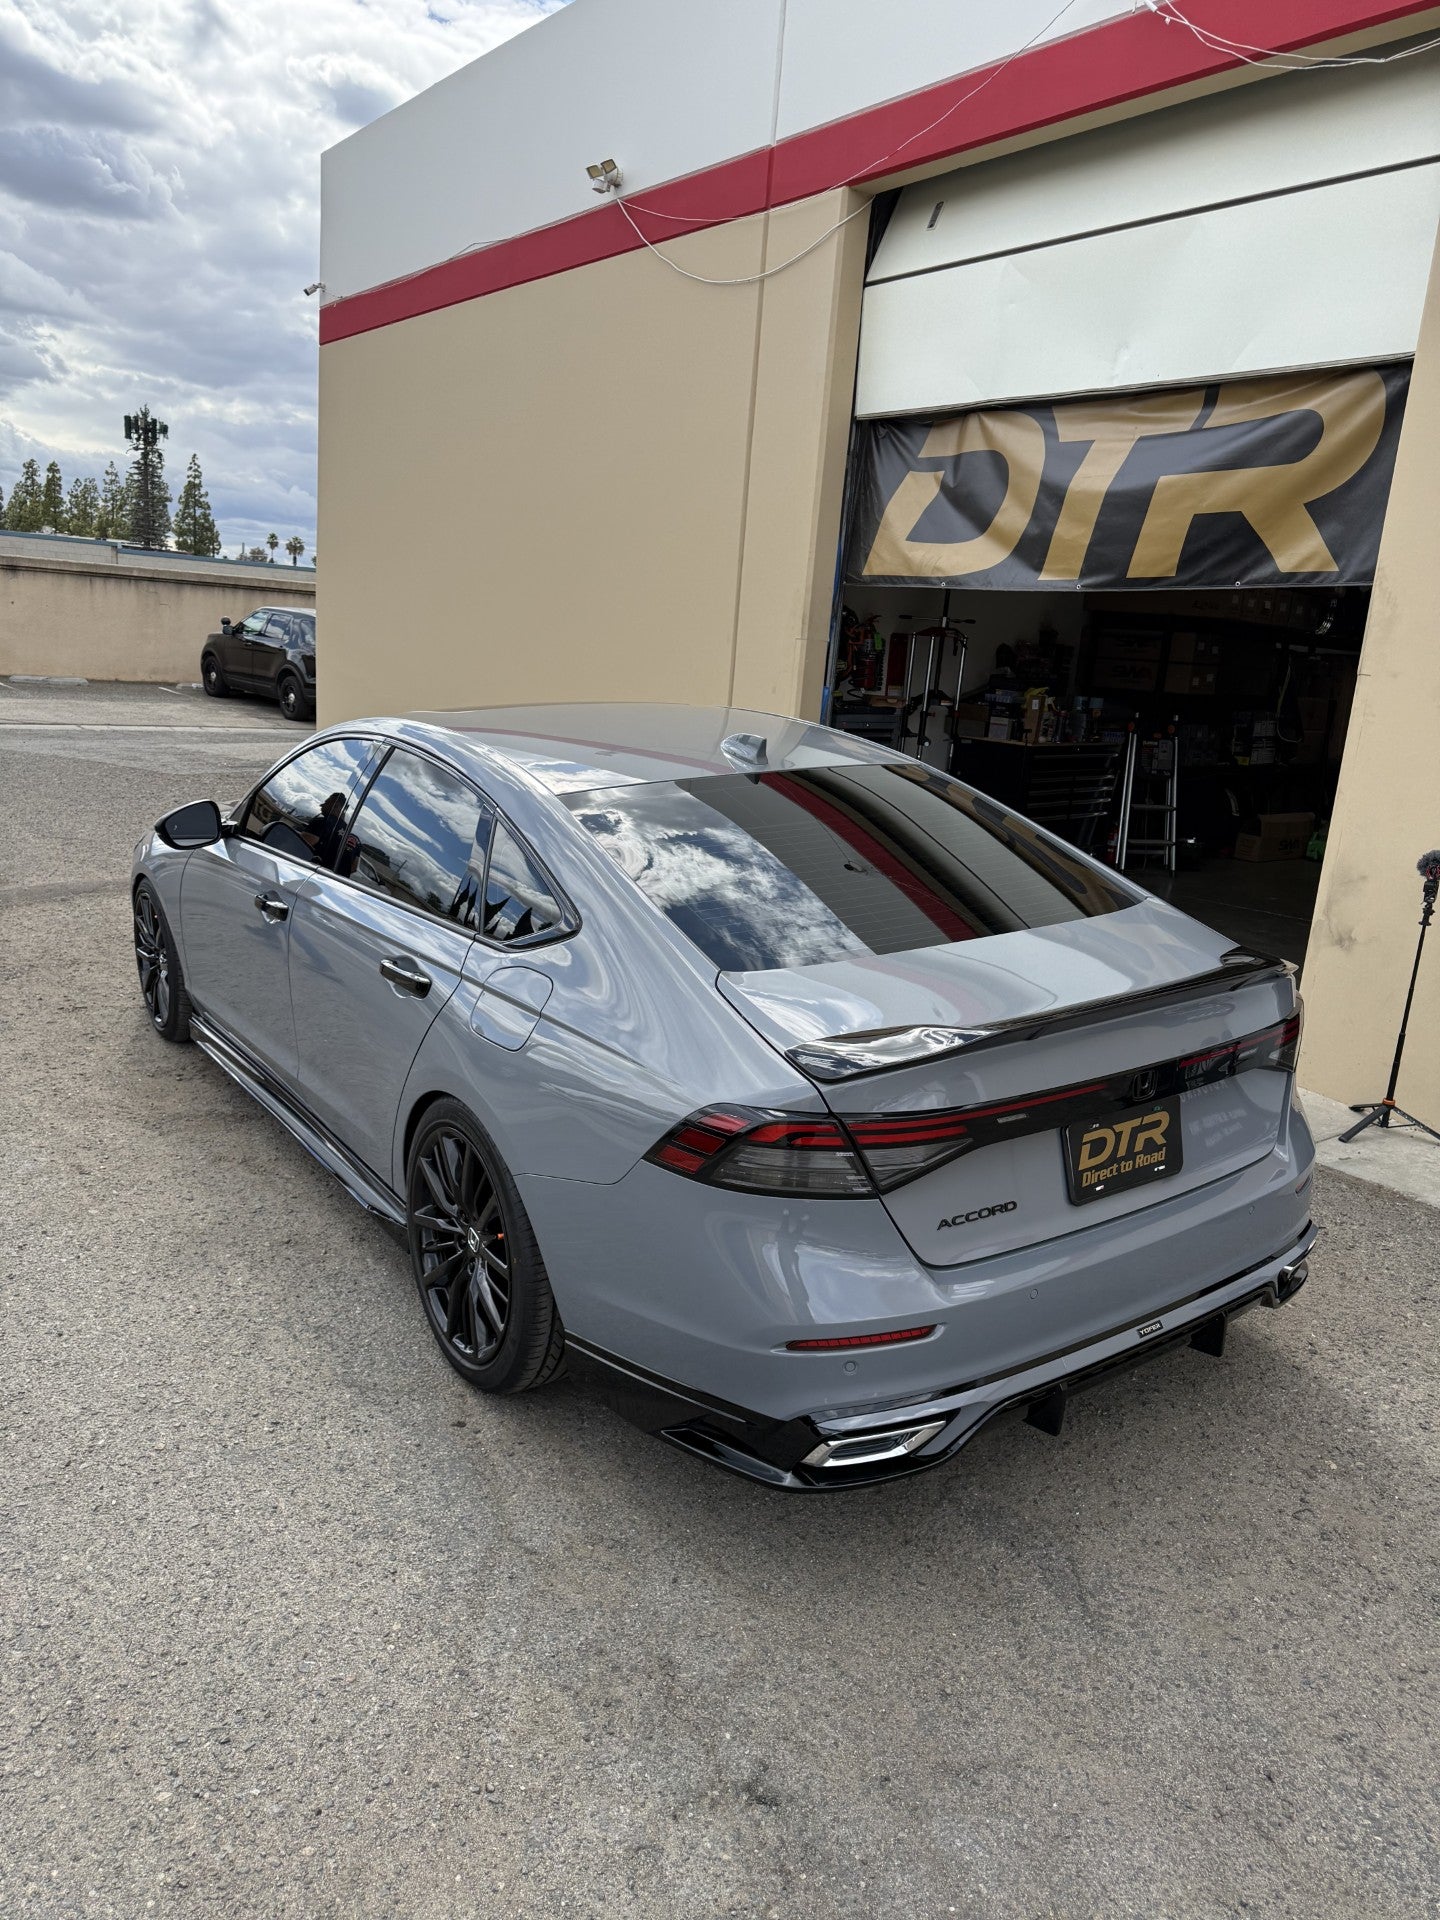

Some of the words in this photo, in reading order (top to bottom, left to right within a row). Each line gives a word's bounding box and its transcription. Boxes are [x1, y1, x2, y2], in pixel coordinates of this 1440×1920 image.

[861, 368, 1387, 581] DTR
[1078, 1110, 1170, 1171] DTR
[1081, 1162, 1118, 1188] Direct
[1120, 1156, 1133, 1172] to
[1135, 1147, 1167, 1169] Road
[936, 1200, 1018, 1231] ACCORD
